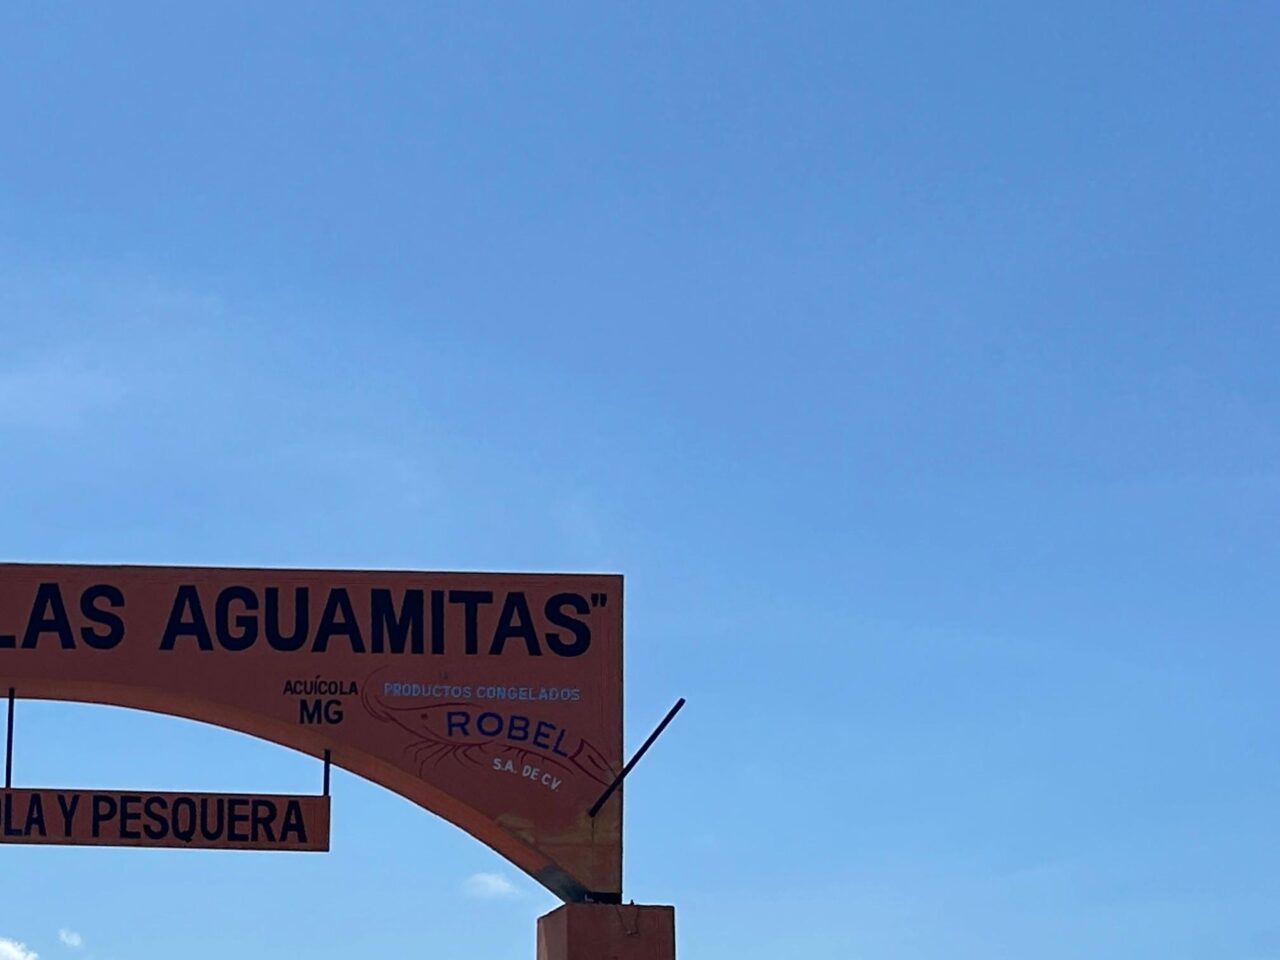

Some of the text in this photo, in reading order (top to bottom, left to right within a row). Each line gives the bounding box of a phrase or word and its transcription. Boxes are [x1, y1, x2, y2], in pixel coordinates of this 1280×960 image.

[159, 585, 608, 657] AGUAMITAS"
[283, 675, 359, 696] ACUÍCOLA
[384, 682, 581, 701] PRODUCTOS CONGELADOS
[299, 699, 344, 725] MG
[447, 711, 569, 757] ROBEL
[522, 765, 540, 781] DE
[57, 795, 78, 837] Y
[92, 795, 307, 843] PESQUERA
